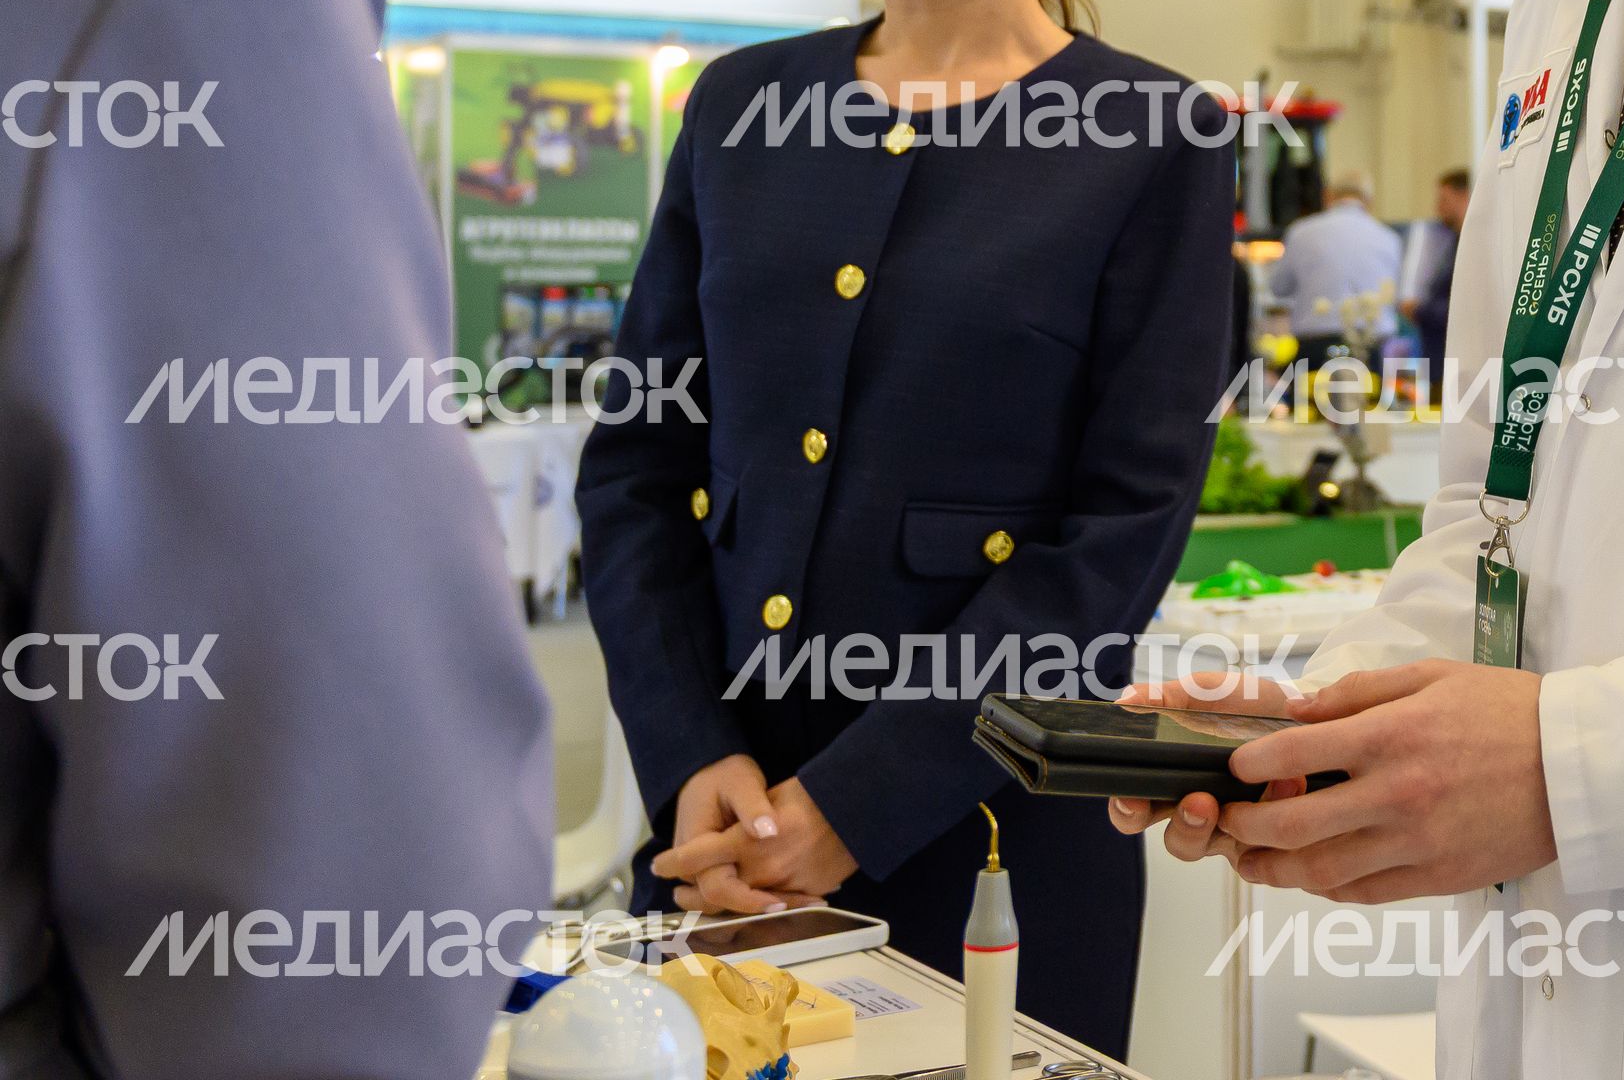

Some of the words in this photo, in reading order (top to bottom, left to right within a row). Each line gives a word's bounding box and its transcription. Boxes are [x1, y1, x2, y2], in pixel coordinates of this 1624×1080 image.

[1561, 57, 1587, 127] РСХБ
[1541, 213, 1557, 252] 2026
[1515, 237, 1541, 316] ЗОЛОТАЯ
[1547, 249, 1590, 326] РСХБ
[1516, 389, 1545, 453] ЗОЛОТА
